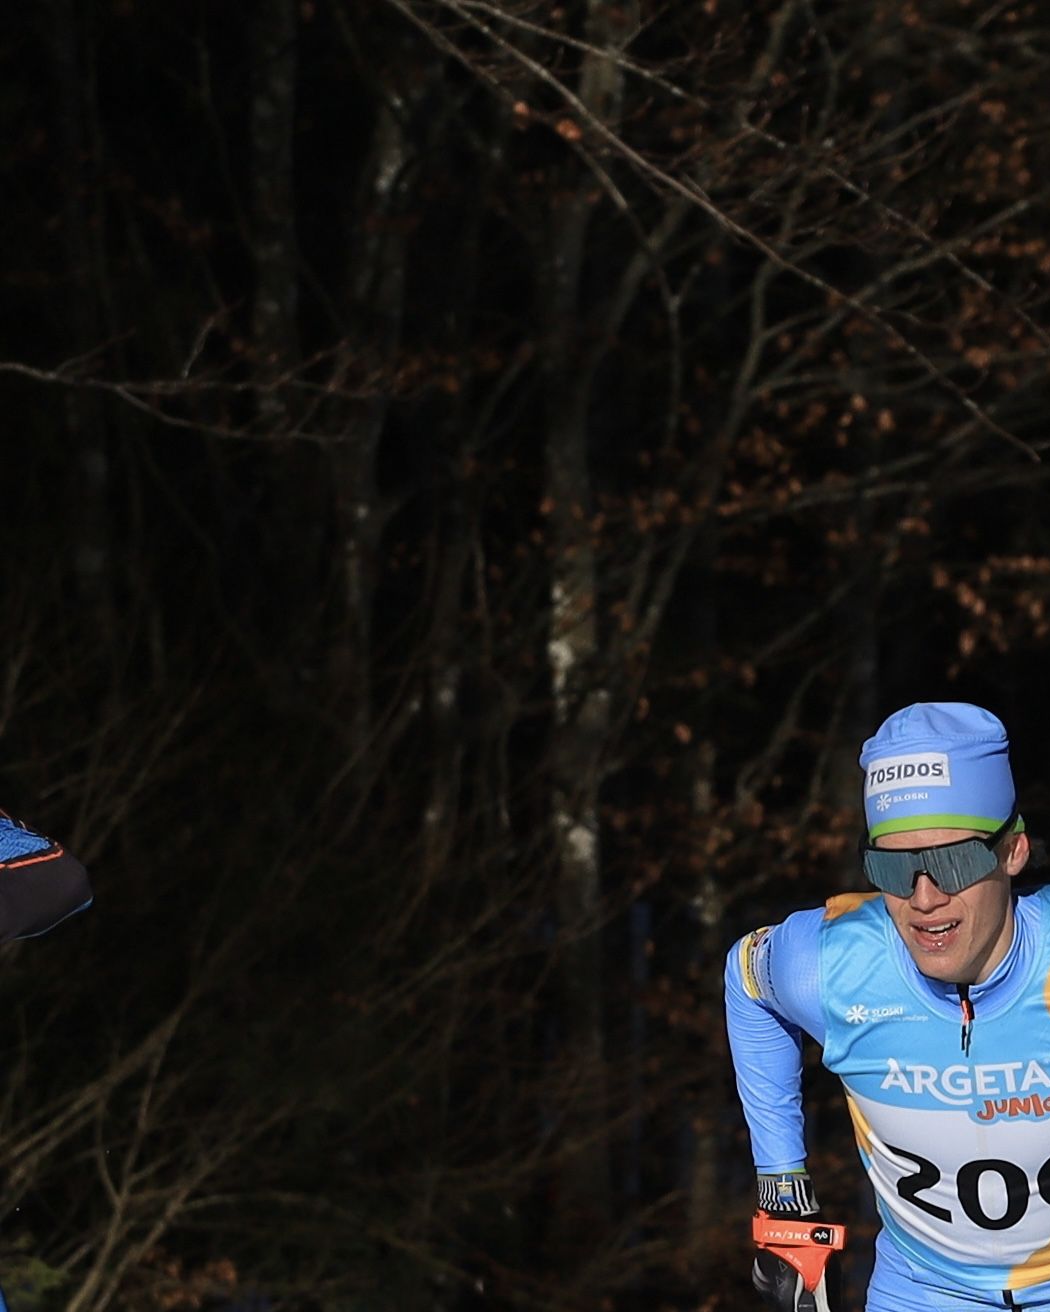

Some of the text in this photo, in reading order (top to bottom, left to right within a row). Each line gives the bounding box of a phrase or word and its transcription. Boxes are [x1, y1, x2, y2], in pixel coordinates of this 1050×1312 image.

[869, 762, 944, 787] TOSIDOS
[892, 791, 929, 804] SLOSKI
[871, 1006, 904, 1018] SLOSKI
